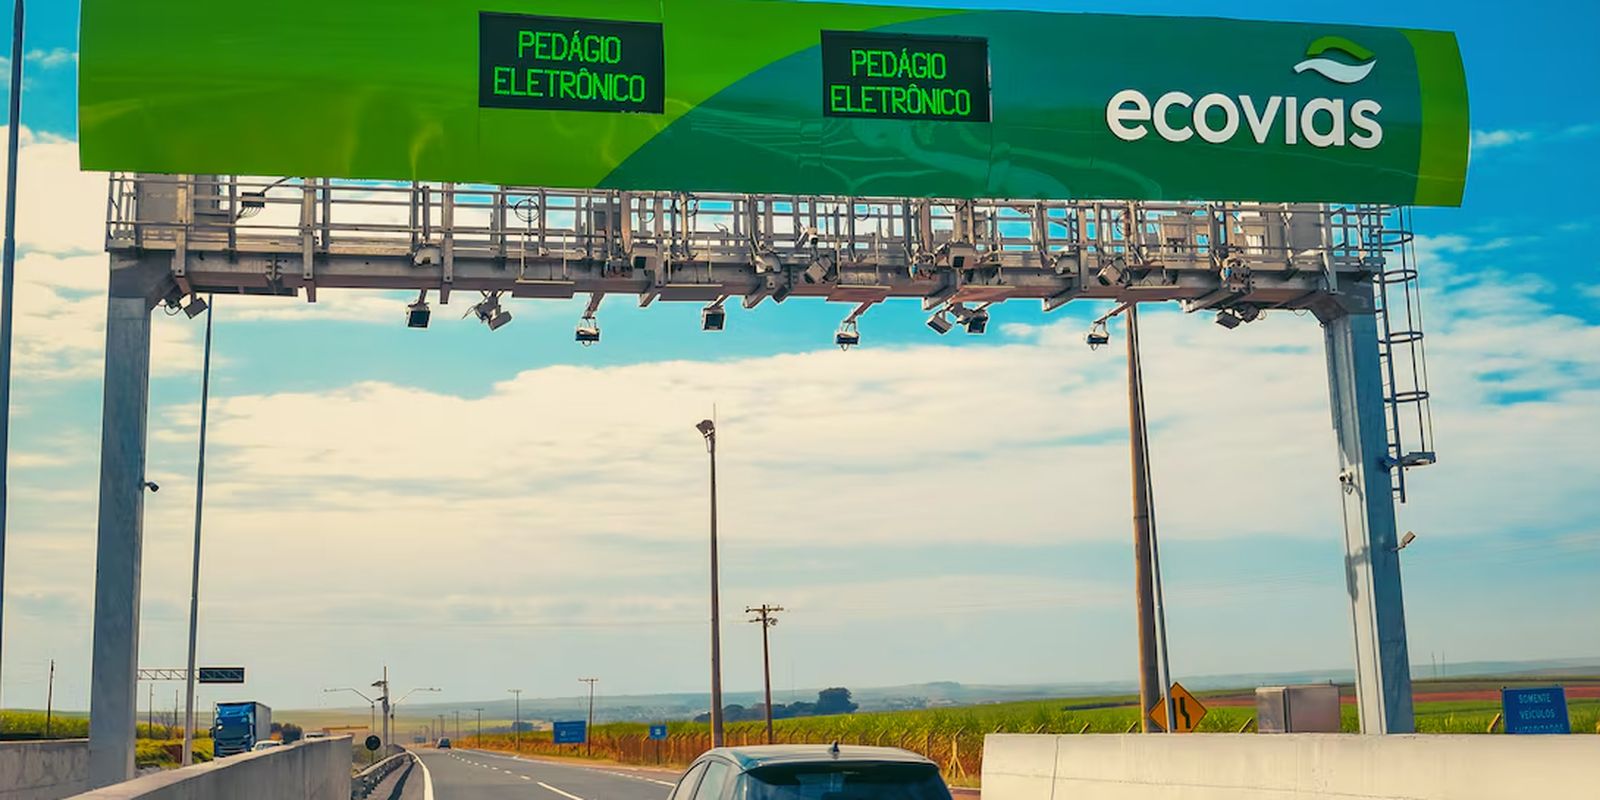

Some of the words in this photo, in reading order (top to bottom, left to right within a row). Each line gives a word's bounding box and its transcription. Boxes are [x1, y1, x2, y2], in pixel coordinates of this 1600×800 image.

[517, 31, 622, 64] PEDÁGIO
[851, 49, 948, 79] PEDÁGIO
[493, 67, 646, 102] ELETRÔNICO
[830, 83, 971, 115] ELETRÔNICO
[1107, 89, 1383, 149] ecovias
[1519, 693, 1551, 704] SOMENTE
